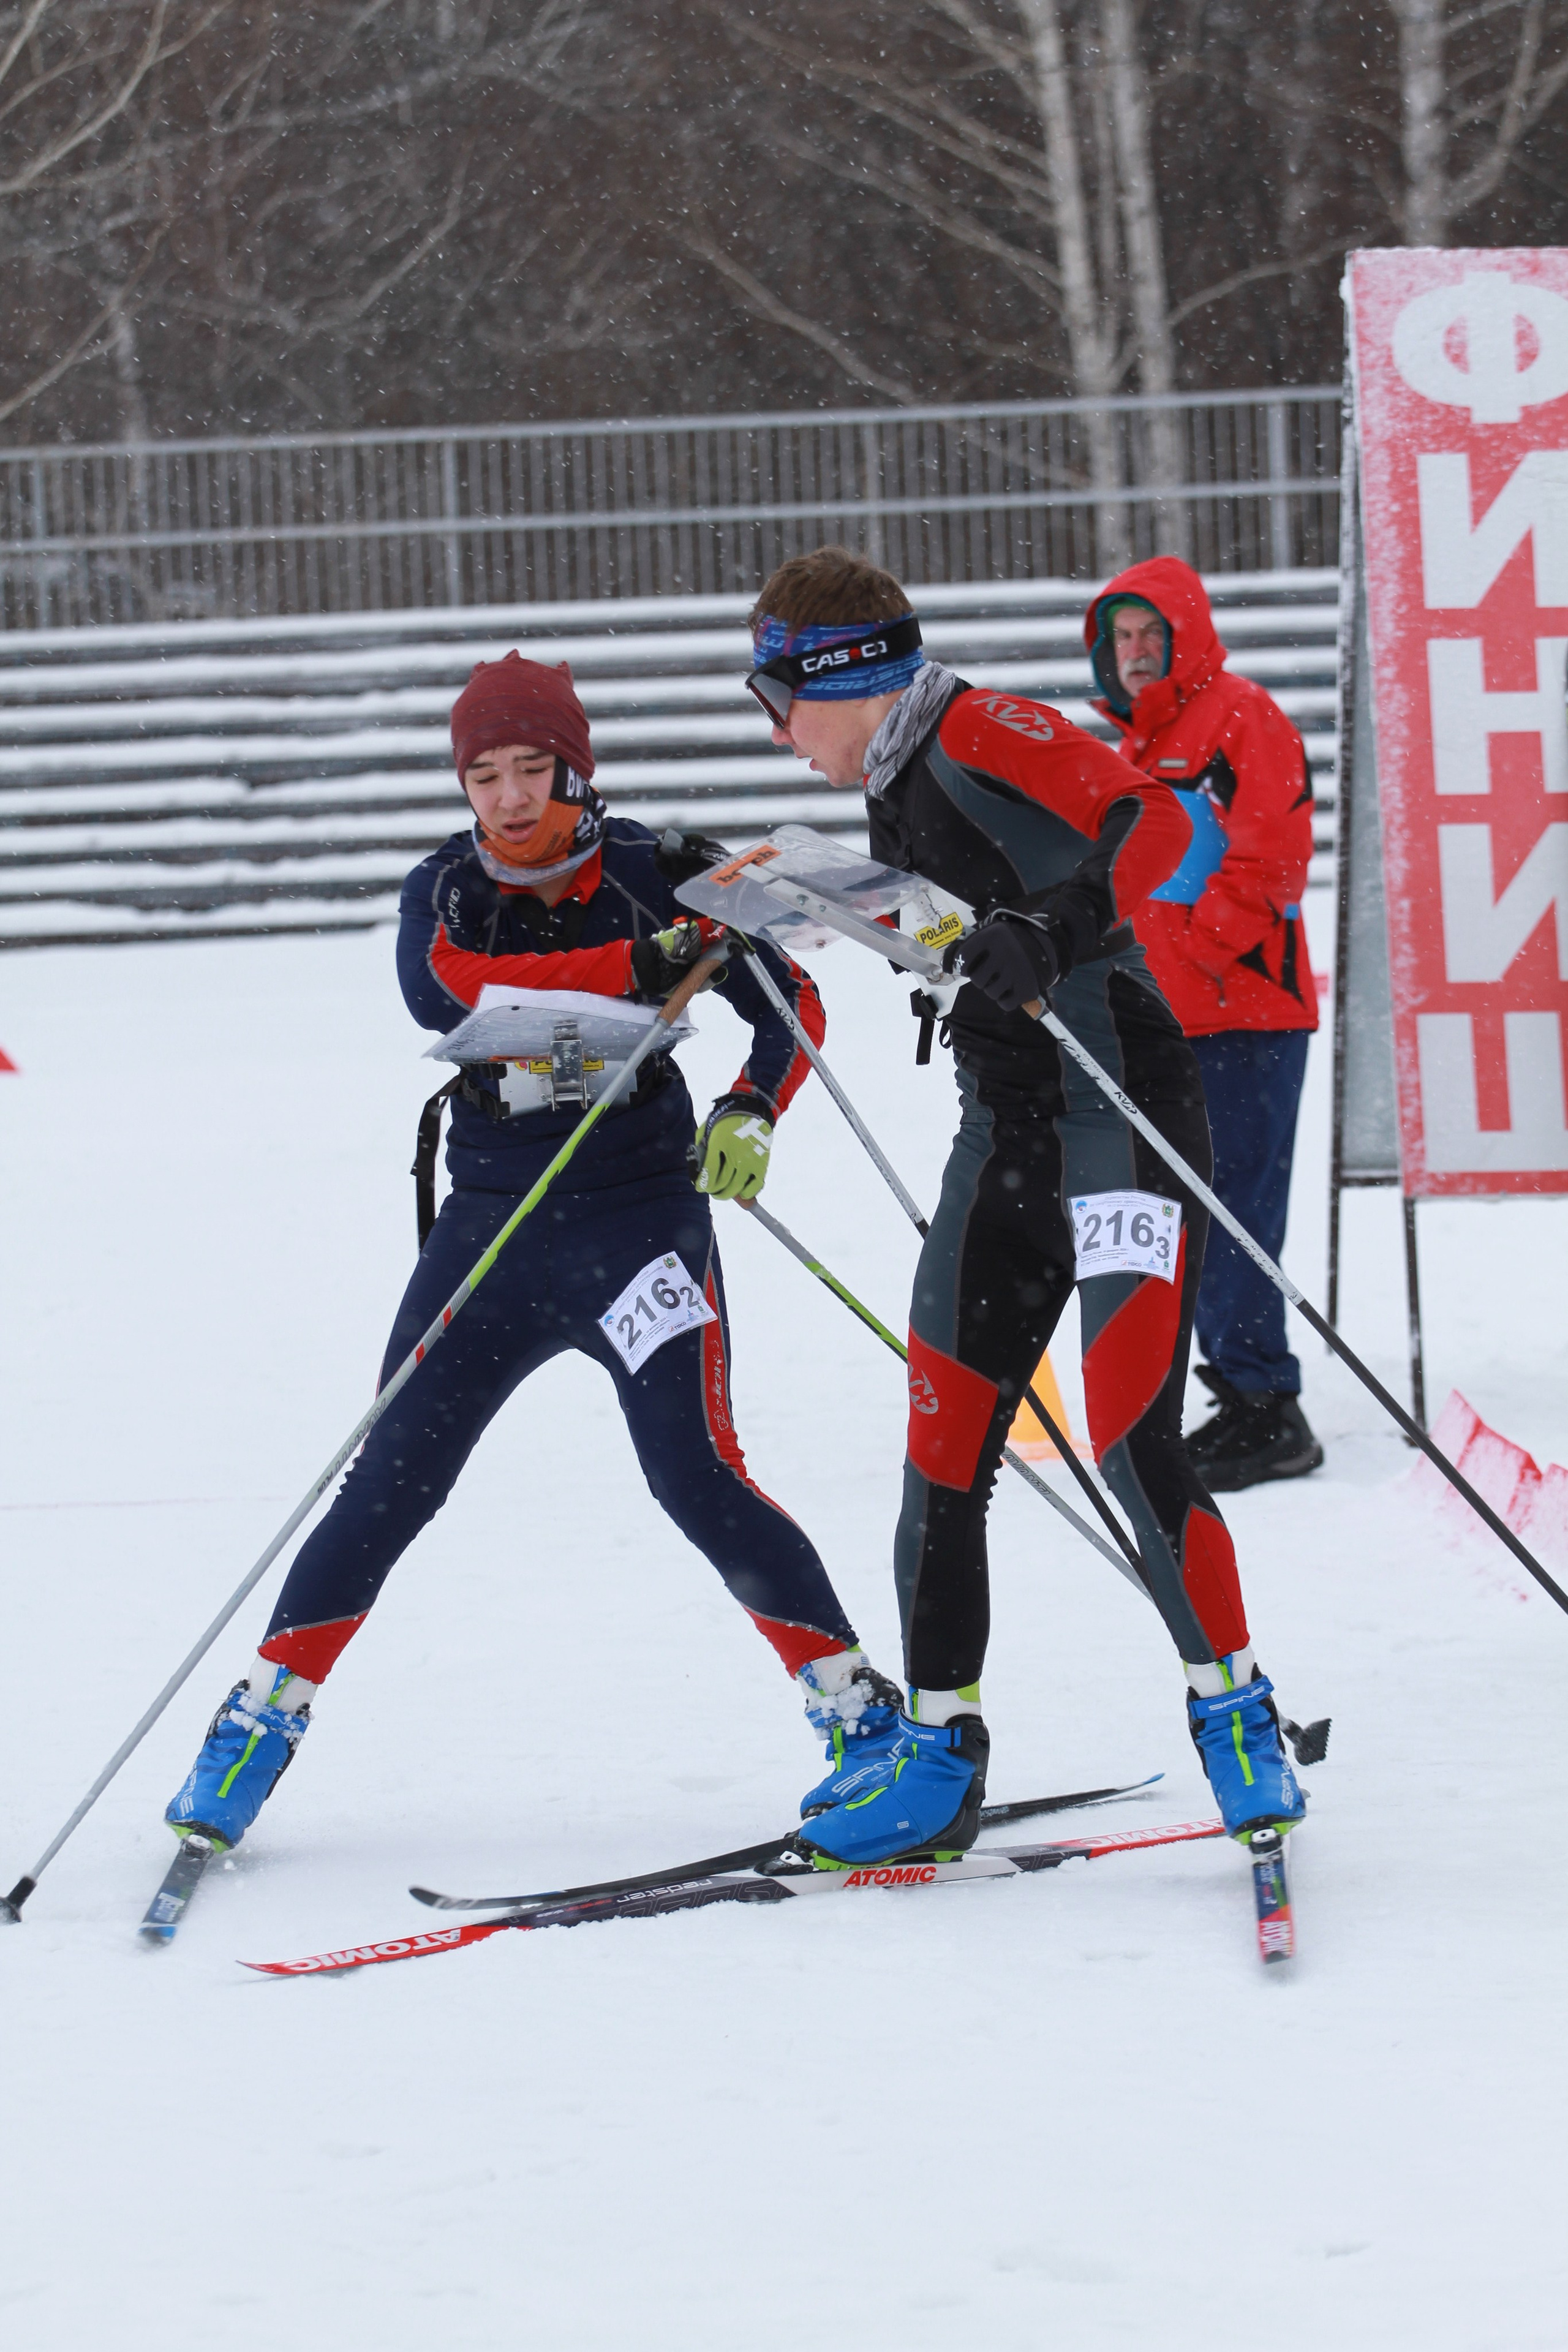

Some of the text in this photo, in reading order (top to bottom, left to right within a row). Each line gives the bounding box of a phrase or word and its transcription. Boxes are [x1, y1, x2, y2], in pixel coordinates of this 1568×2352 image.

[1392, 270, 1568, 1173] ФИНИШ
[920, 917, 960, 944] POLARIS
[1082, 1210, 1155, 1253] 216
[1155, 1236, 1170, 1259] 3
[617, 1278, 681, 1351] 216
[679, 1286, 700, 1308] 2
[1003, 1453, 1051, 1498] AVANTI
[1209, 1685, 1265, 1711] SPINE
[616, 1878, 714, 1904] redster
[843, 1866, 937, 1888] ATOMIC
[284, 1928, 462, 1971] ATOMIC
